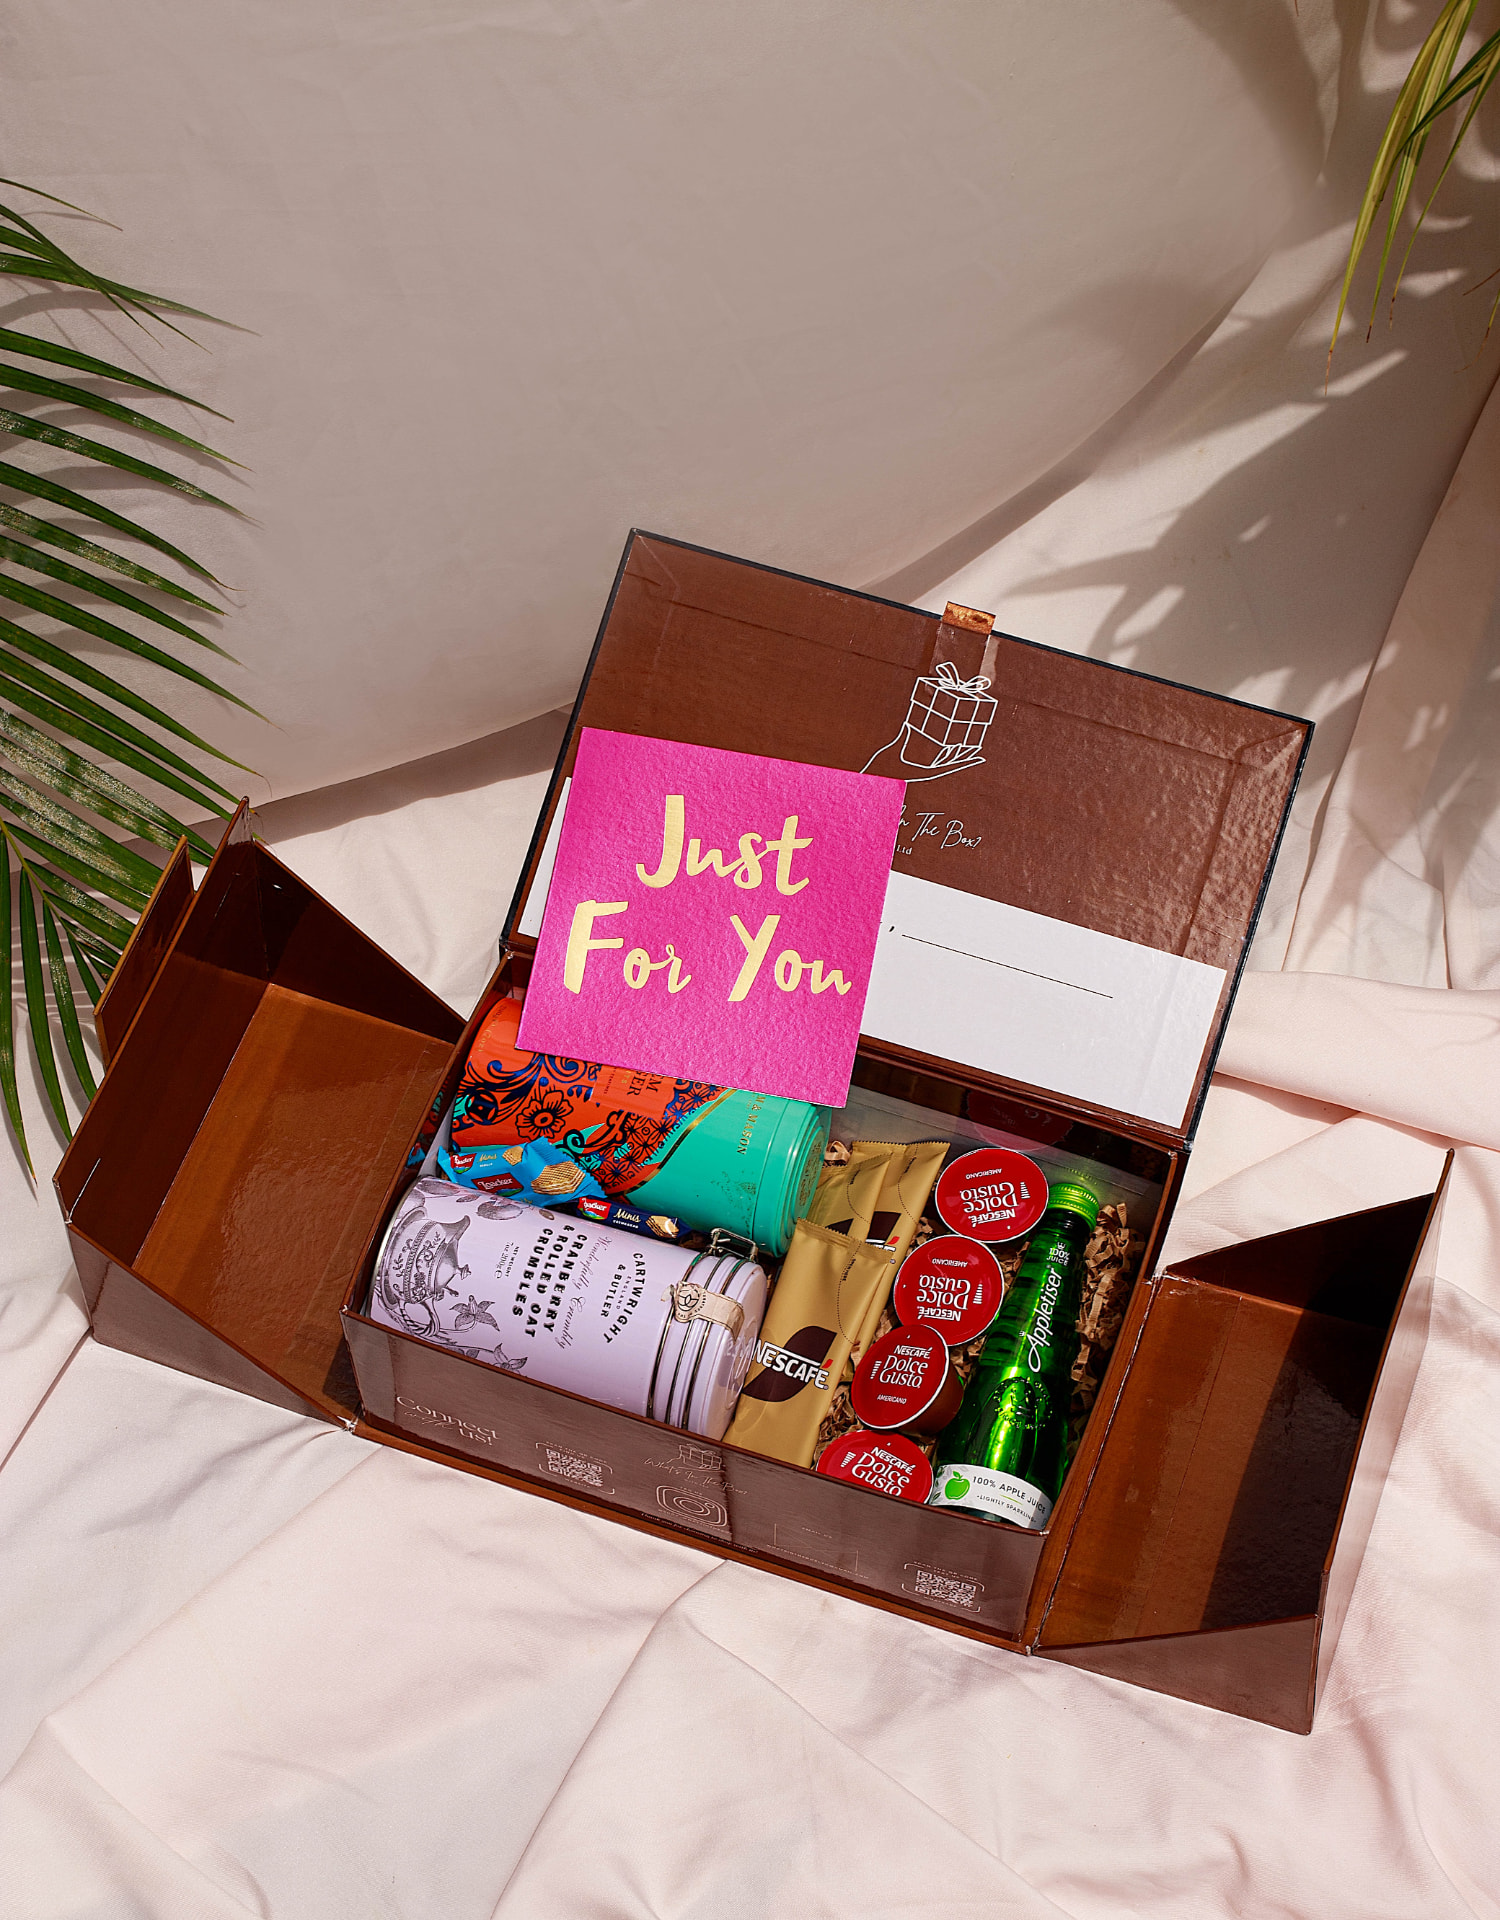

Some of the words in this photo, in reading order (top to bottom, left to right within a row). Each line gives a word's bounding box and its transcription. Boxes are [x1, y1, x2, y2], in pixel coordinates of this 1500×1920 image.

[911, 811, 945, 842] The
[636, 794, 814, 896] Just
[563, 899, 692, 995] For
[727, 914, 853, 1002] You
[736, 1113, 758, 1156] MASON
[965, 1168, 1002, 1180] AMERICANO
[960, 1181, 1015, 1203] Gusto
[963, 1192, 1018, 1213] Dolce
[536, 1235, 569, 1295] ROLLED
[931, 1258, 968, 1268] AMERICANO
[1046, 1255, 1069, 1267] JUICE
[1048, 1247, 1071, 1261] 100%
[512, 1228, 554, 1317] CRUMBLES
[543, 1234, 588, 1333] CRANBERRY
[918, 1274, 971, 1296] Gusto
[600, 1274, 622, 1318] BUTLER
[602, 1252, 646, 1344] CARTWRIGHT
[916, 1288, 970, 1311] Dolce
[525, 1302, 542, 1338] OAT
[1027, 1267, 1063, 1373] Appletiser
[879, 1369, 923, 1388] Gusto
[882, 1354, 929, 1375] Dolce
[876, 1394, 907, 1405] AMERICANO
[396, 1396, 501, 1440] Connect
[459, 1428, 493, 1446] us!
[851, 1463, 902, 1497] Gusto
[857, 1451, 910, 1488] Dolce
[973, 1476, 997, 1489] 100%
[999, 1483, 1026, 1500] APPLE
[1027, 1496, 1046, 1514] JUICE
